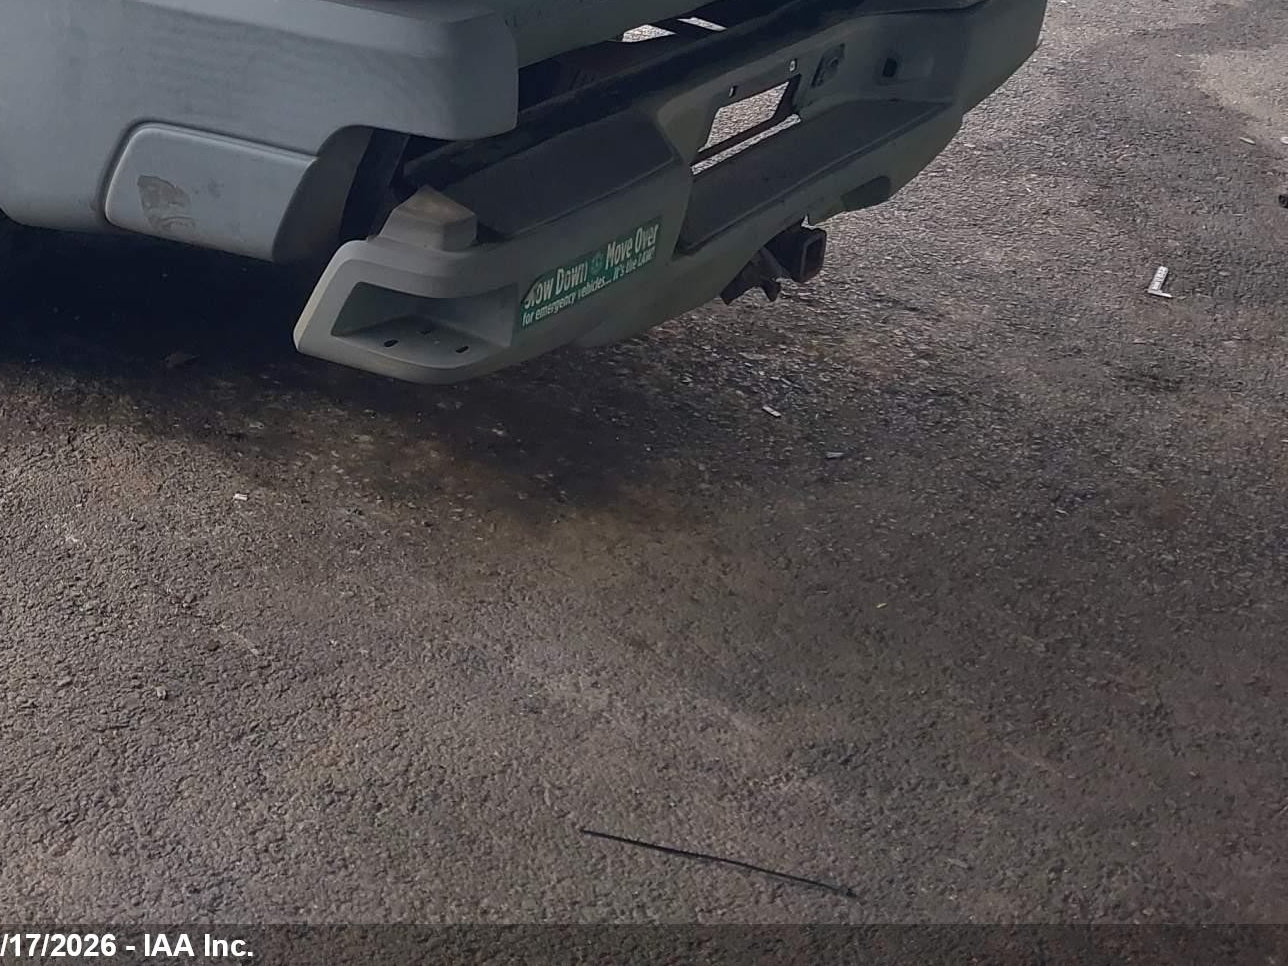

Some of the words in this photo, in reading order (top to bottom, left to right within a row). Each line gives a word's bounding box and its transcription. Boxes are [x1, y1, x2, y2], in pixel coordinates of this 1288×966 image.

[556, 260, 588, 296] Down
[605, 237, 634, 271] Move
[634, 223, 661, 254] Over
[522, 310, 535, 327] for
